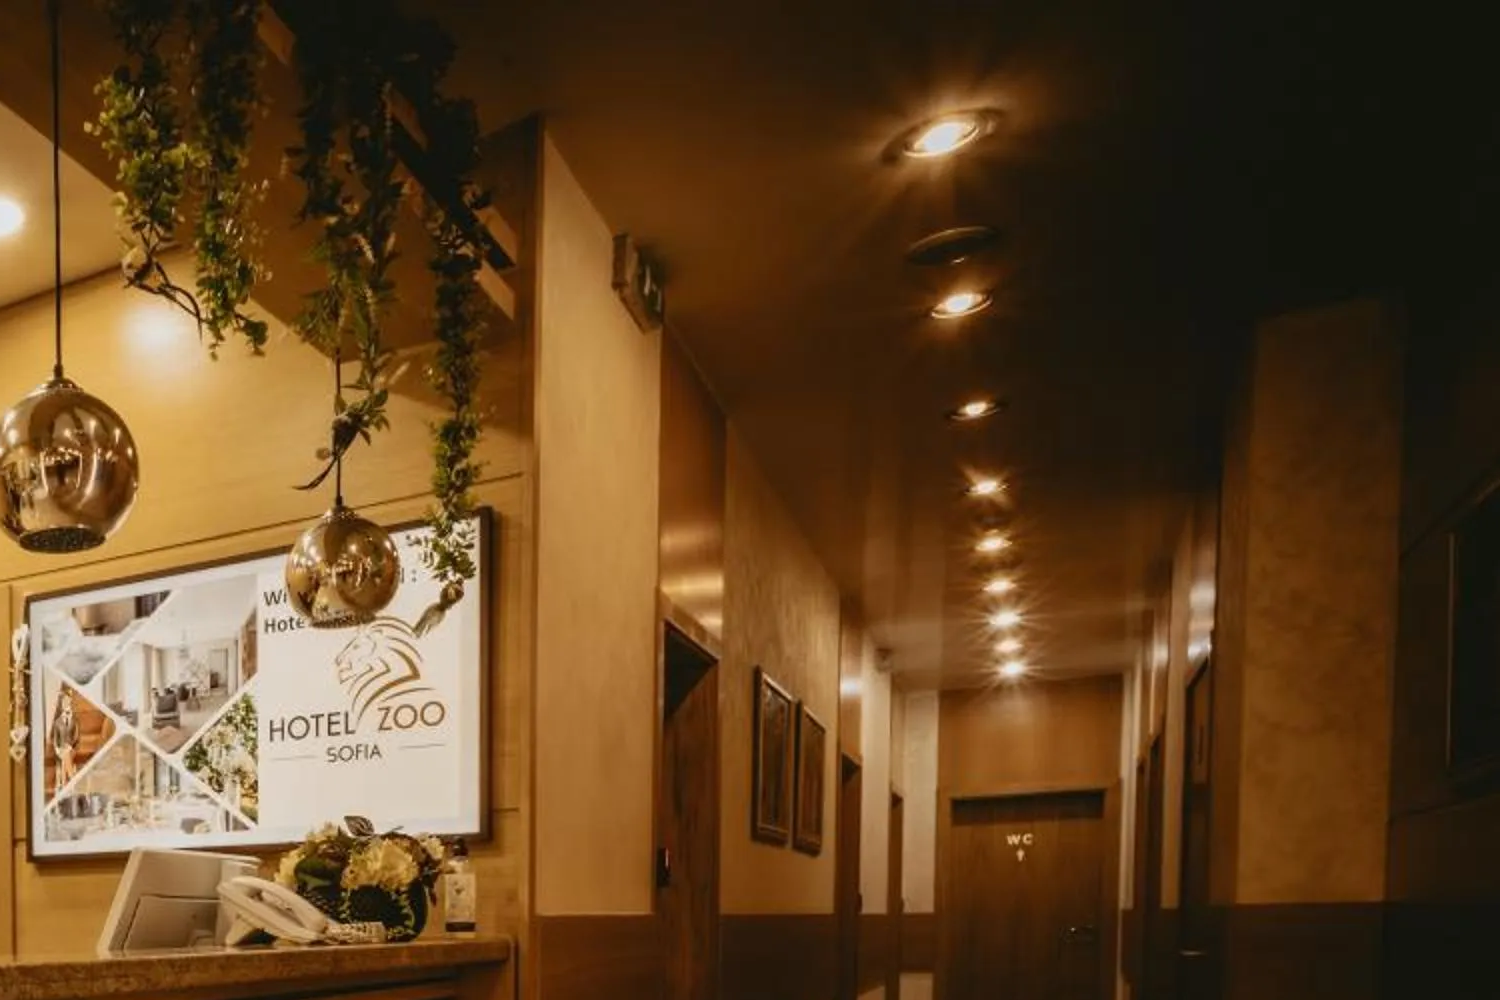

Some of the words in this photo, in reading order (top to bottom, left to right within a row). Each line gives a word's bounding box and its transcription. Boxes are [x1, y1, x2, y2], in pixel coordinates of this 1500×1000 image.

[264, 616, 306, 634] Hote
[268, 710, 357, 743] HOTEL
[377, 700, 446, 732] ZOO
[326, 743, 383, 764] SOFIA
[1006, 832, 1034, 846] WC
